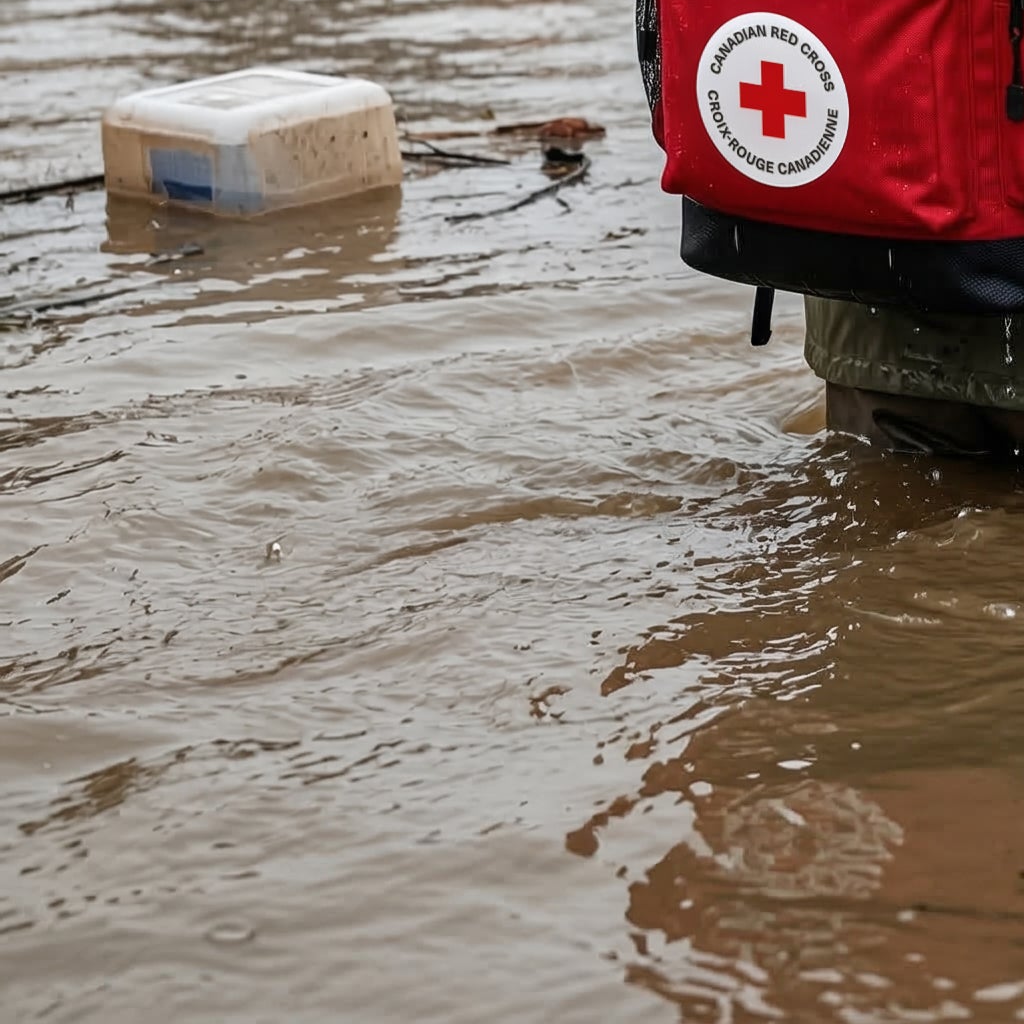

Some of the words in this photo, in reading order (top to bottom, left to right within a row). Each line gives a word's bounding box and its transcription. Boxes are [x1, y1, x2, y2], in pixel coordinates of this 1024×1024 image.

[710, 24, 767, 75] CANADIAN
[770, 25, 799, 46] RED
[800, 42, 835, 92] CROSS
[707, 89, 774, 174] CROIX-ROUGE
[777, 107, 839, 175] CANADIENNE
